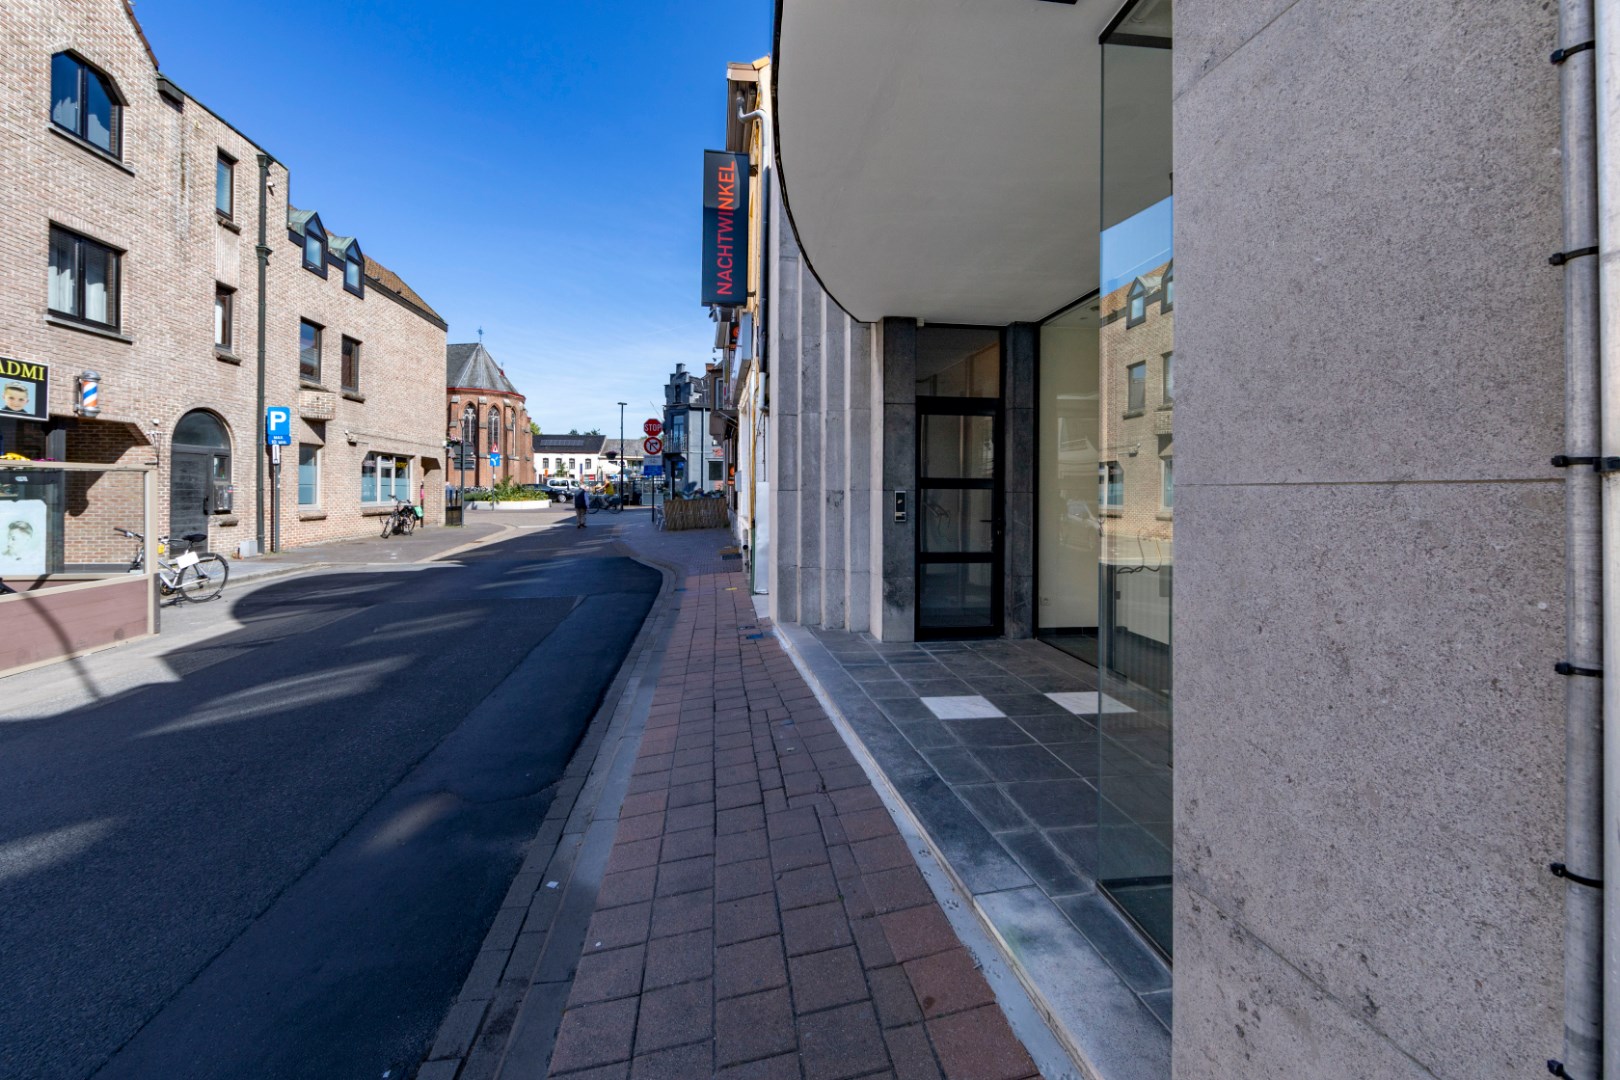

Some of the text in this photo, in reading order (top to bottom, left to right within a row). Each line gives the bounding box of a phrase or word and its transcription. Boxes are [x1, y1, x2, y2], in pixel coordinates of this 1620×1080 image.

[717, 160, 735, 295] NACHTWINKEL
[270, 411, 287, 431] P
[644, 423, 662, 431] STOP
